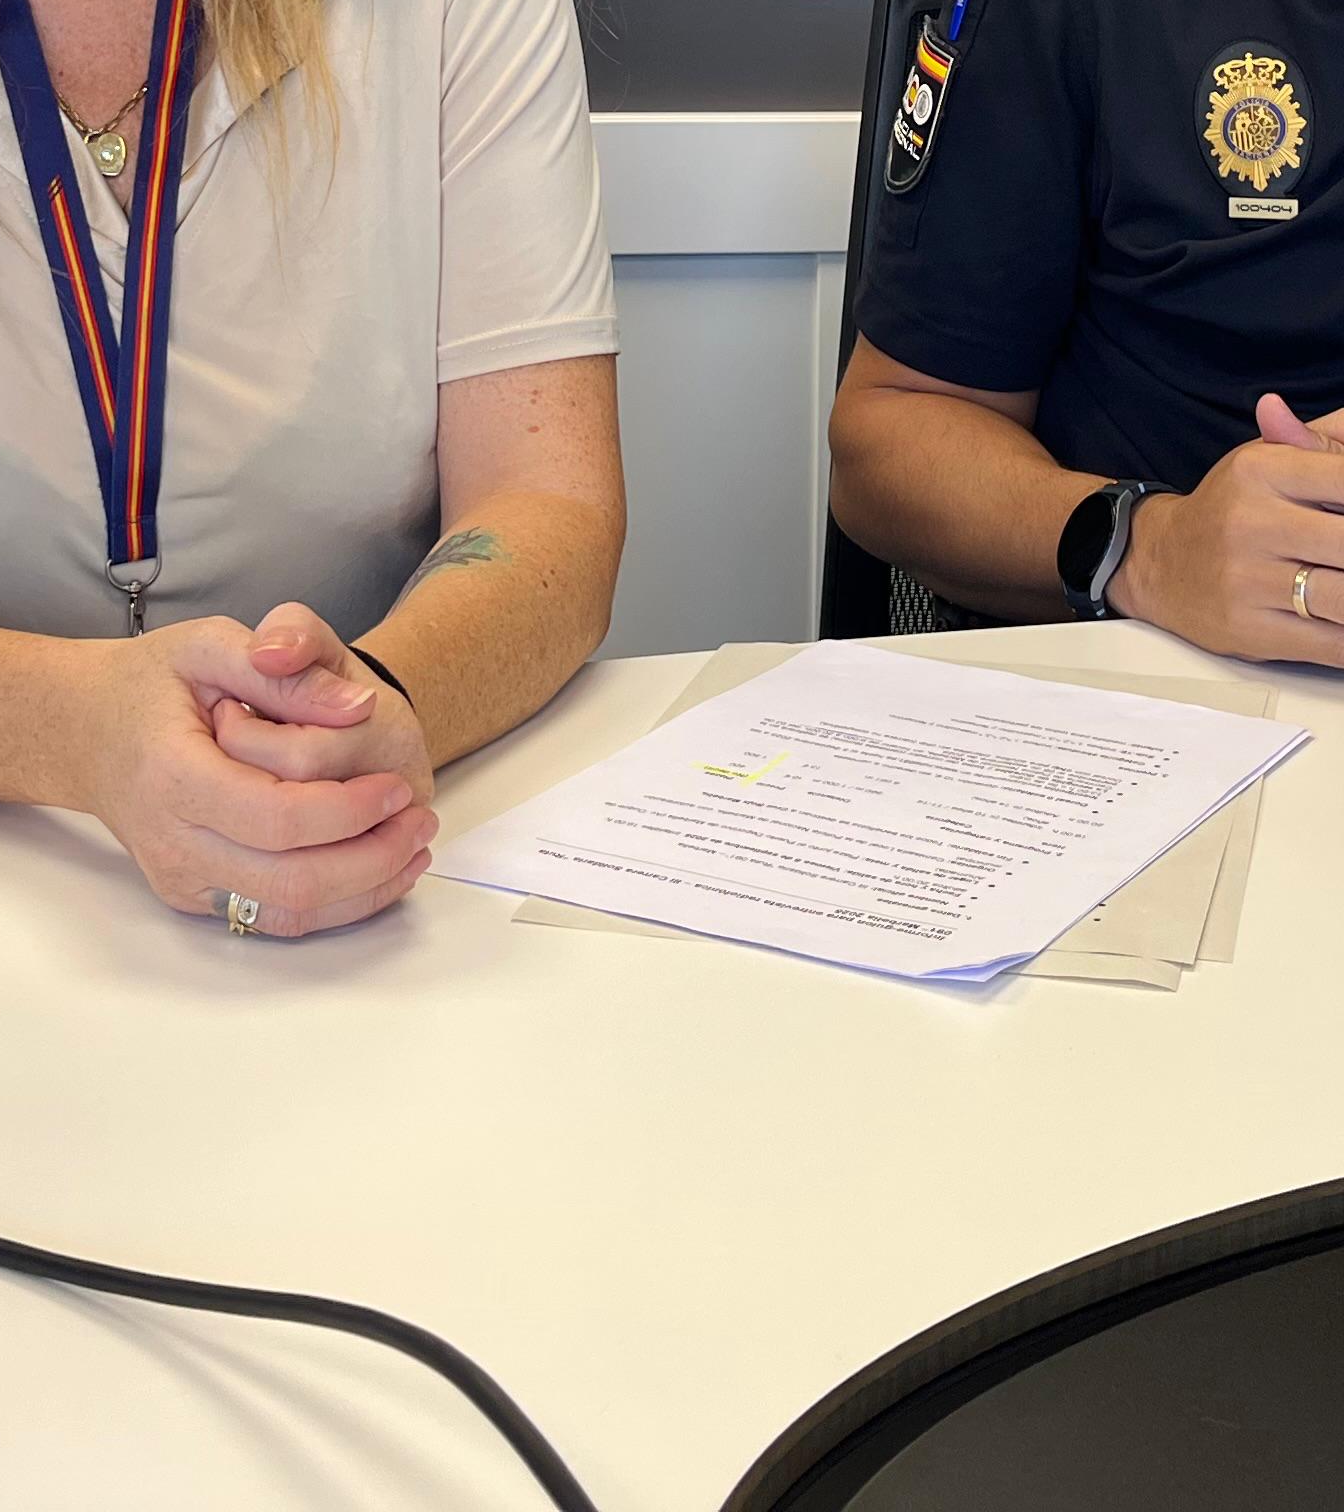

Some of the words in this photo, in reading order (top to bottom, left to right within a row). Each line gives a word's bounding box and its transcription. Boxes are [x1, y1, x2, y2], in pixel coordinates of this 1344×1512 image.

[1236, 203, 1293, 215] 100404
[573, 856, 622, 872] Solidaria
[626, 867, 667, 881] Carrera
[868, 914, 920, 929] Marbella
